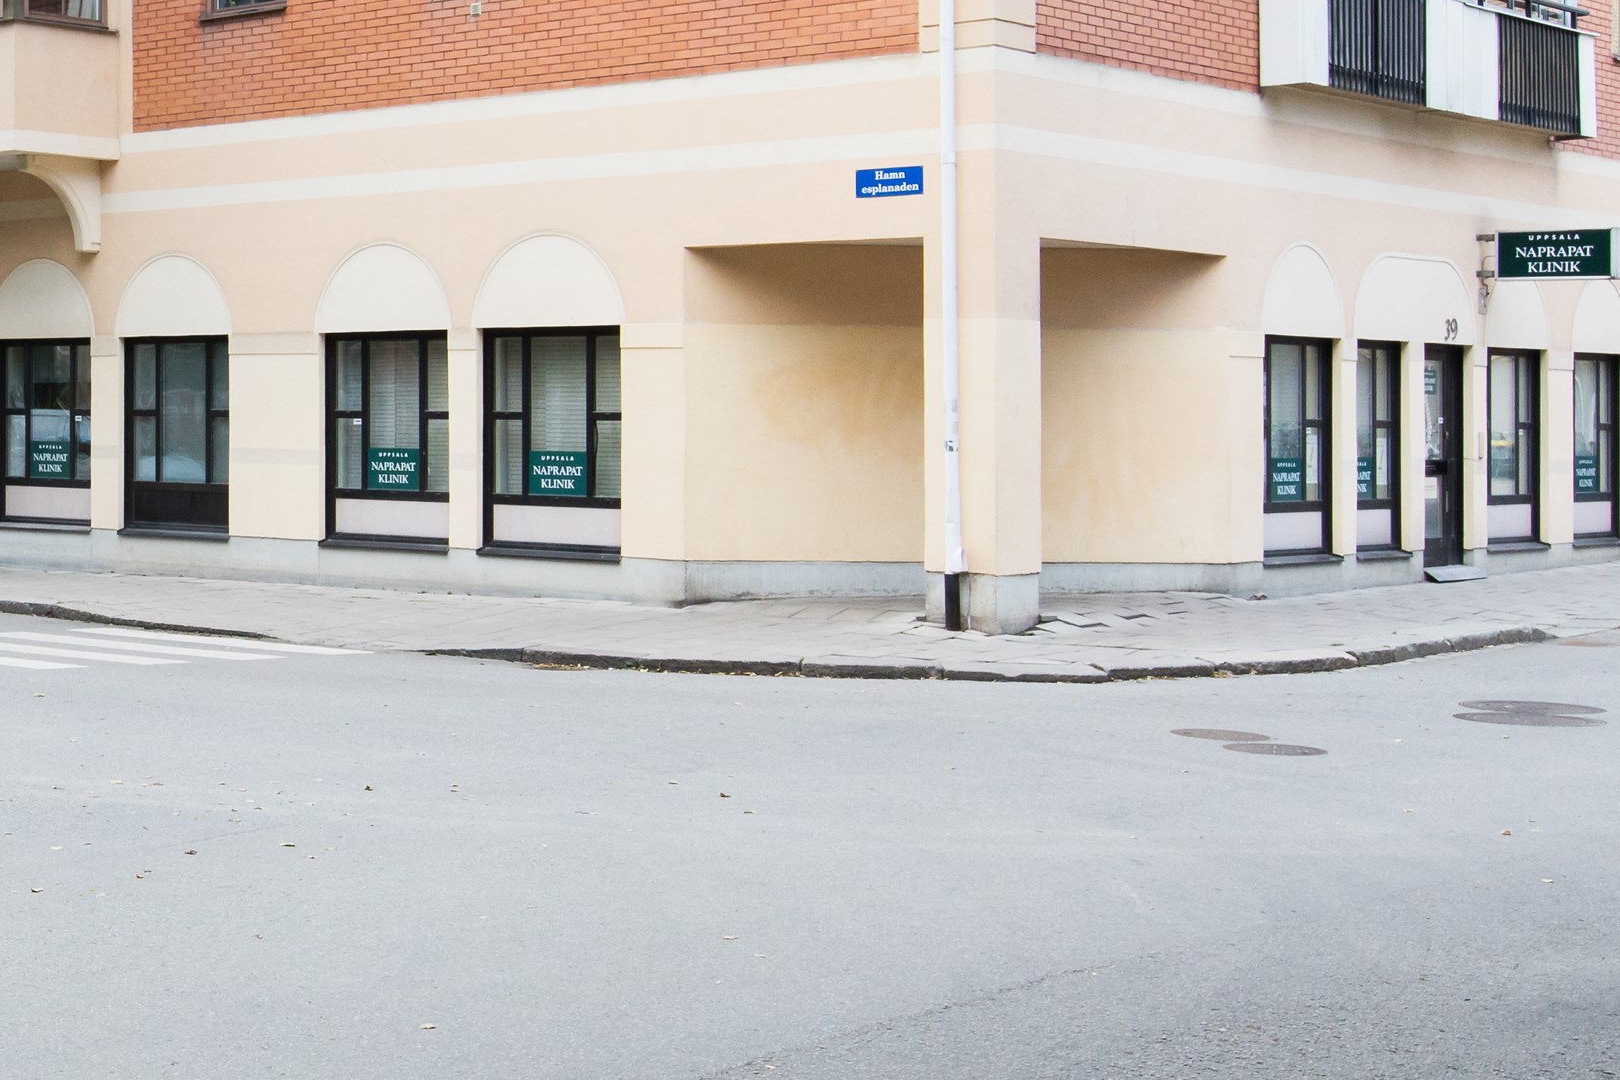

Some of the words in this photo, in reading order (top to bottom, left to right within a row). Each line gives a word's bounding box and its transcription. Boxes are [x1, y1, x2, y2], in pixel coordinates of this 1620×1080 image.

[874, 170, 906, 181] Hamn
[861, 182, 919, 195] esplanaden
[1528, 233, 1580, 241] UPPSALA
[1515, 245, 1594, 258] NAPRAPAT
[1527, 261, 1581, 273] KLINIK
[1444, 318, 1459, 341] 39
[33, 453, 68, 462] NAPRAPAT
[38, 463, 62, 472] KLINIK
[371, 461, 416, 471] NAPRAPAT
[533, 465, 583, 476] NAPRAPAT
[378, 473, 409, 484] KLINIK
[1272, 472, 1300, 482] NAPRAPAT
[540, 478, 575, 489] KLINIK
[1277, 485, 1296, 495] KLINIK
